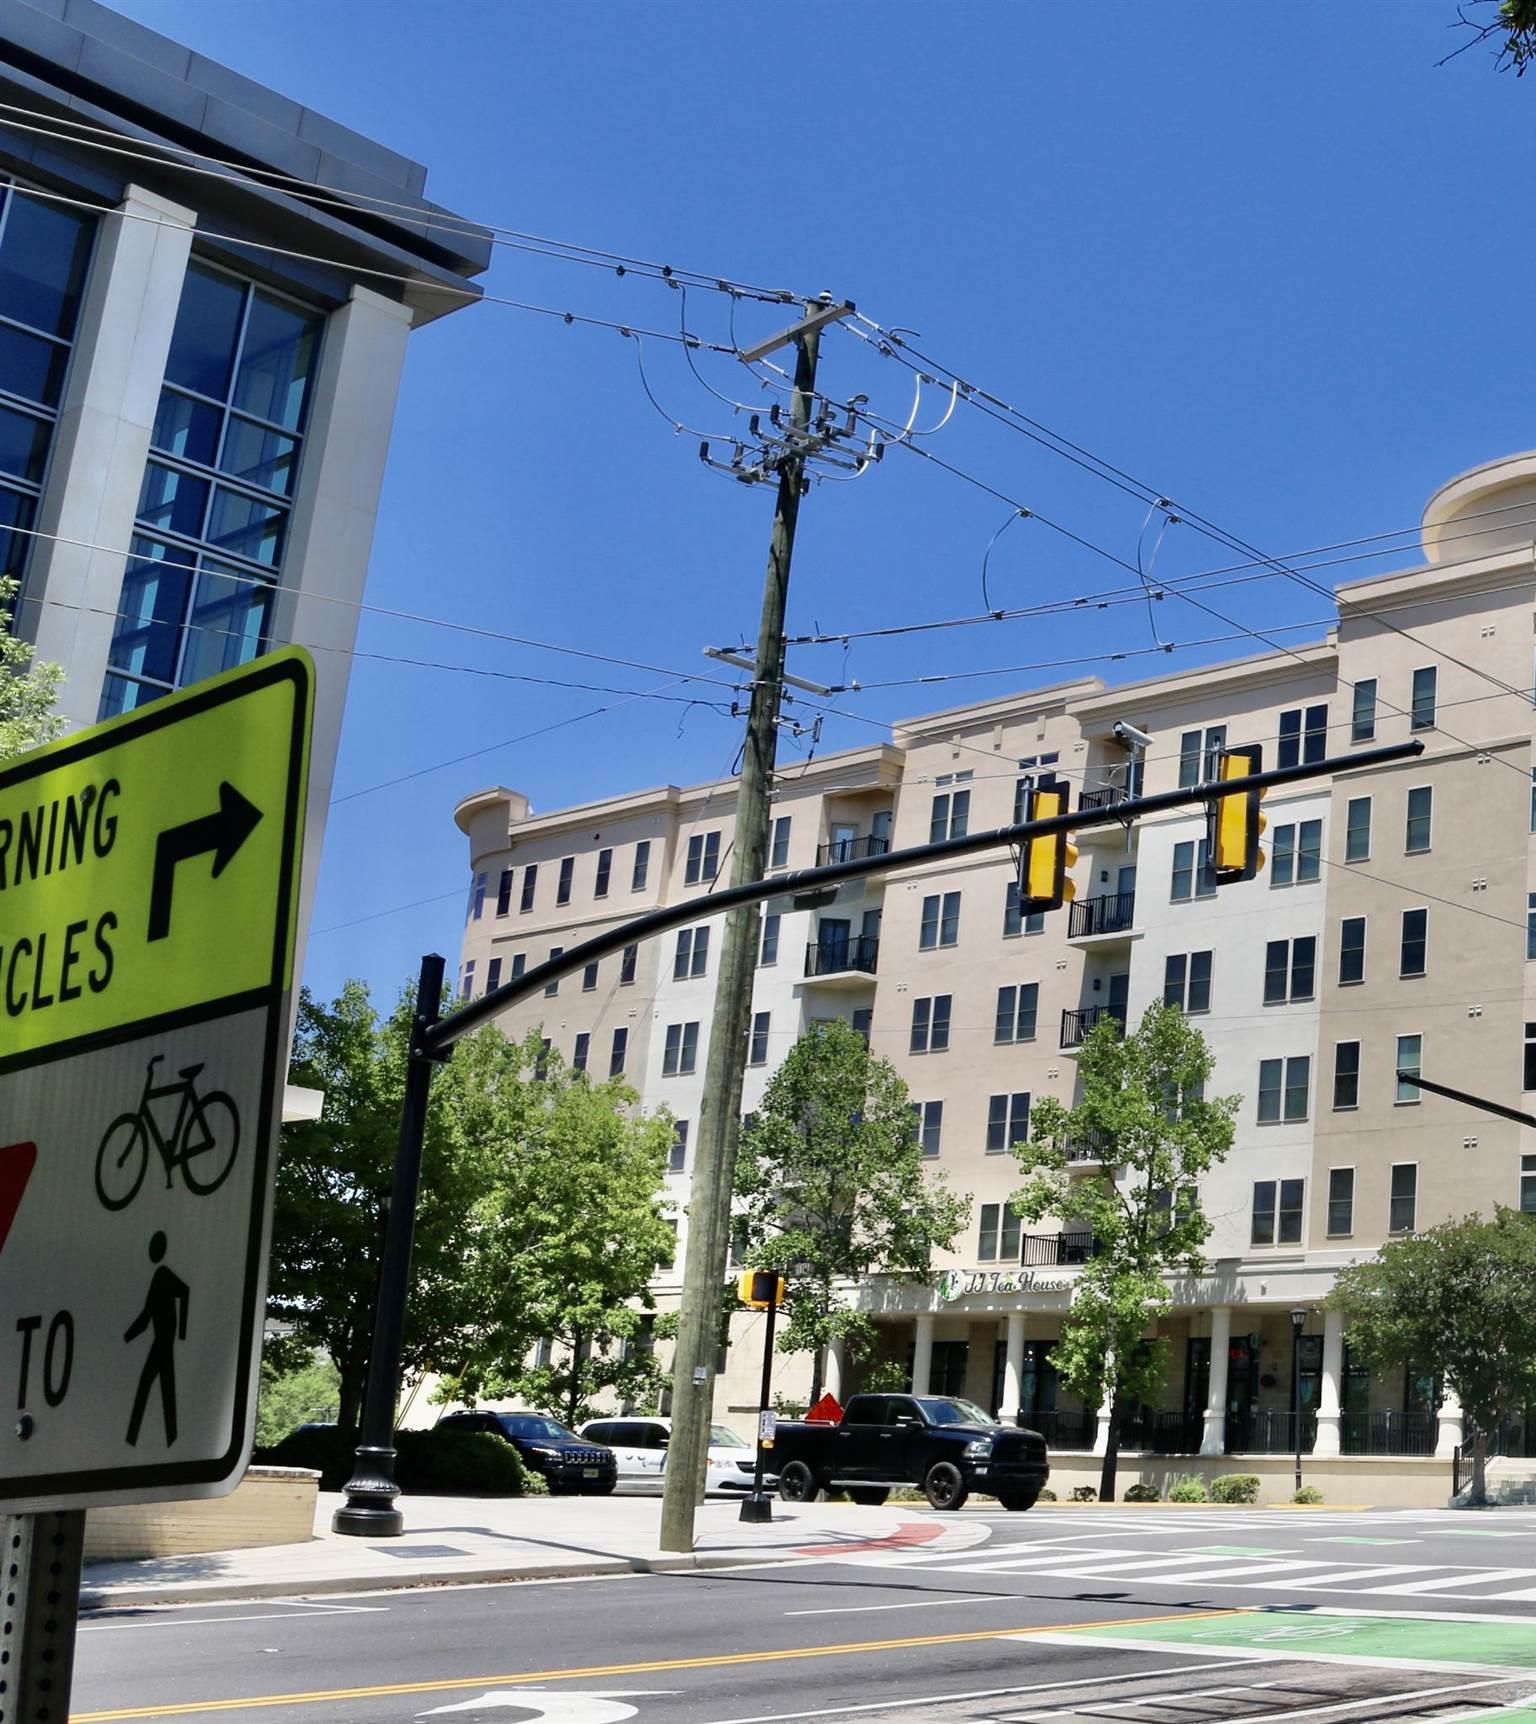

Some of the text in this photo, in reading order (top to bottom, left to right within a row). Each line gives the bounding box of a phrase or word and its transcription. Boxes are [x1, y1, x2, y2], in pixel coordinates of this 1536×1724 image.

[0, 910, 119, 1018] CLES
[1018, 1271, 1064, 1293] House
[15, 1309, 75, 1408] TO
